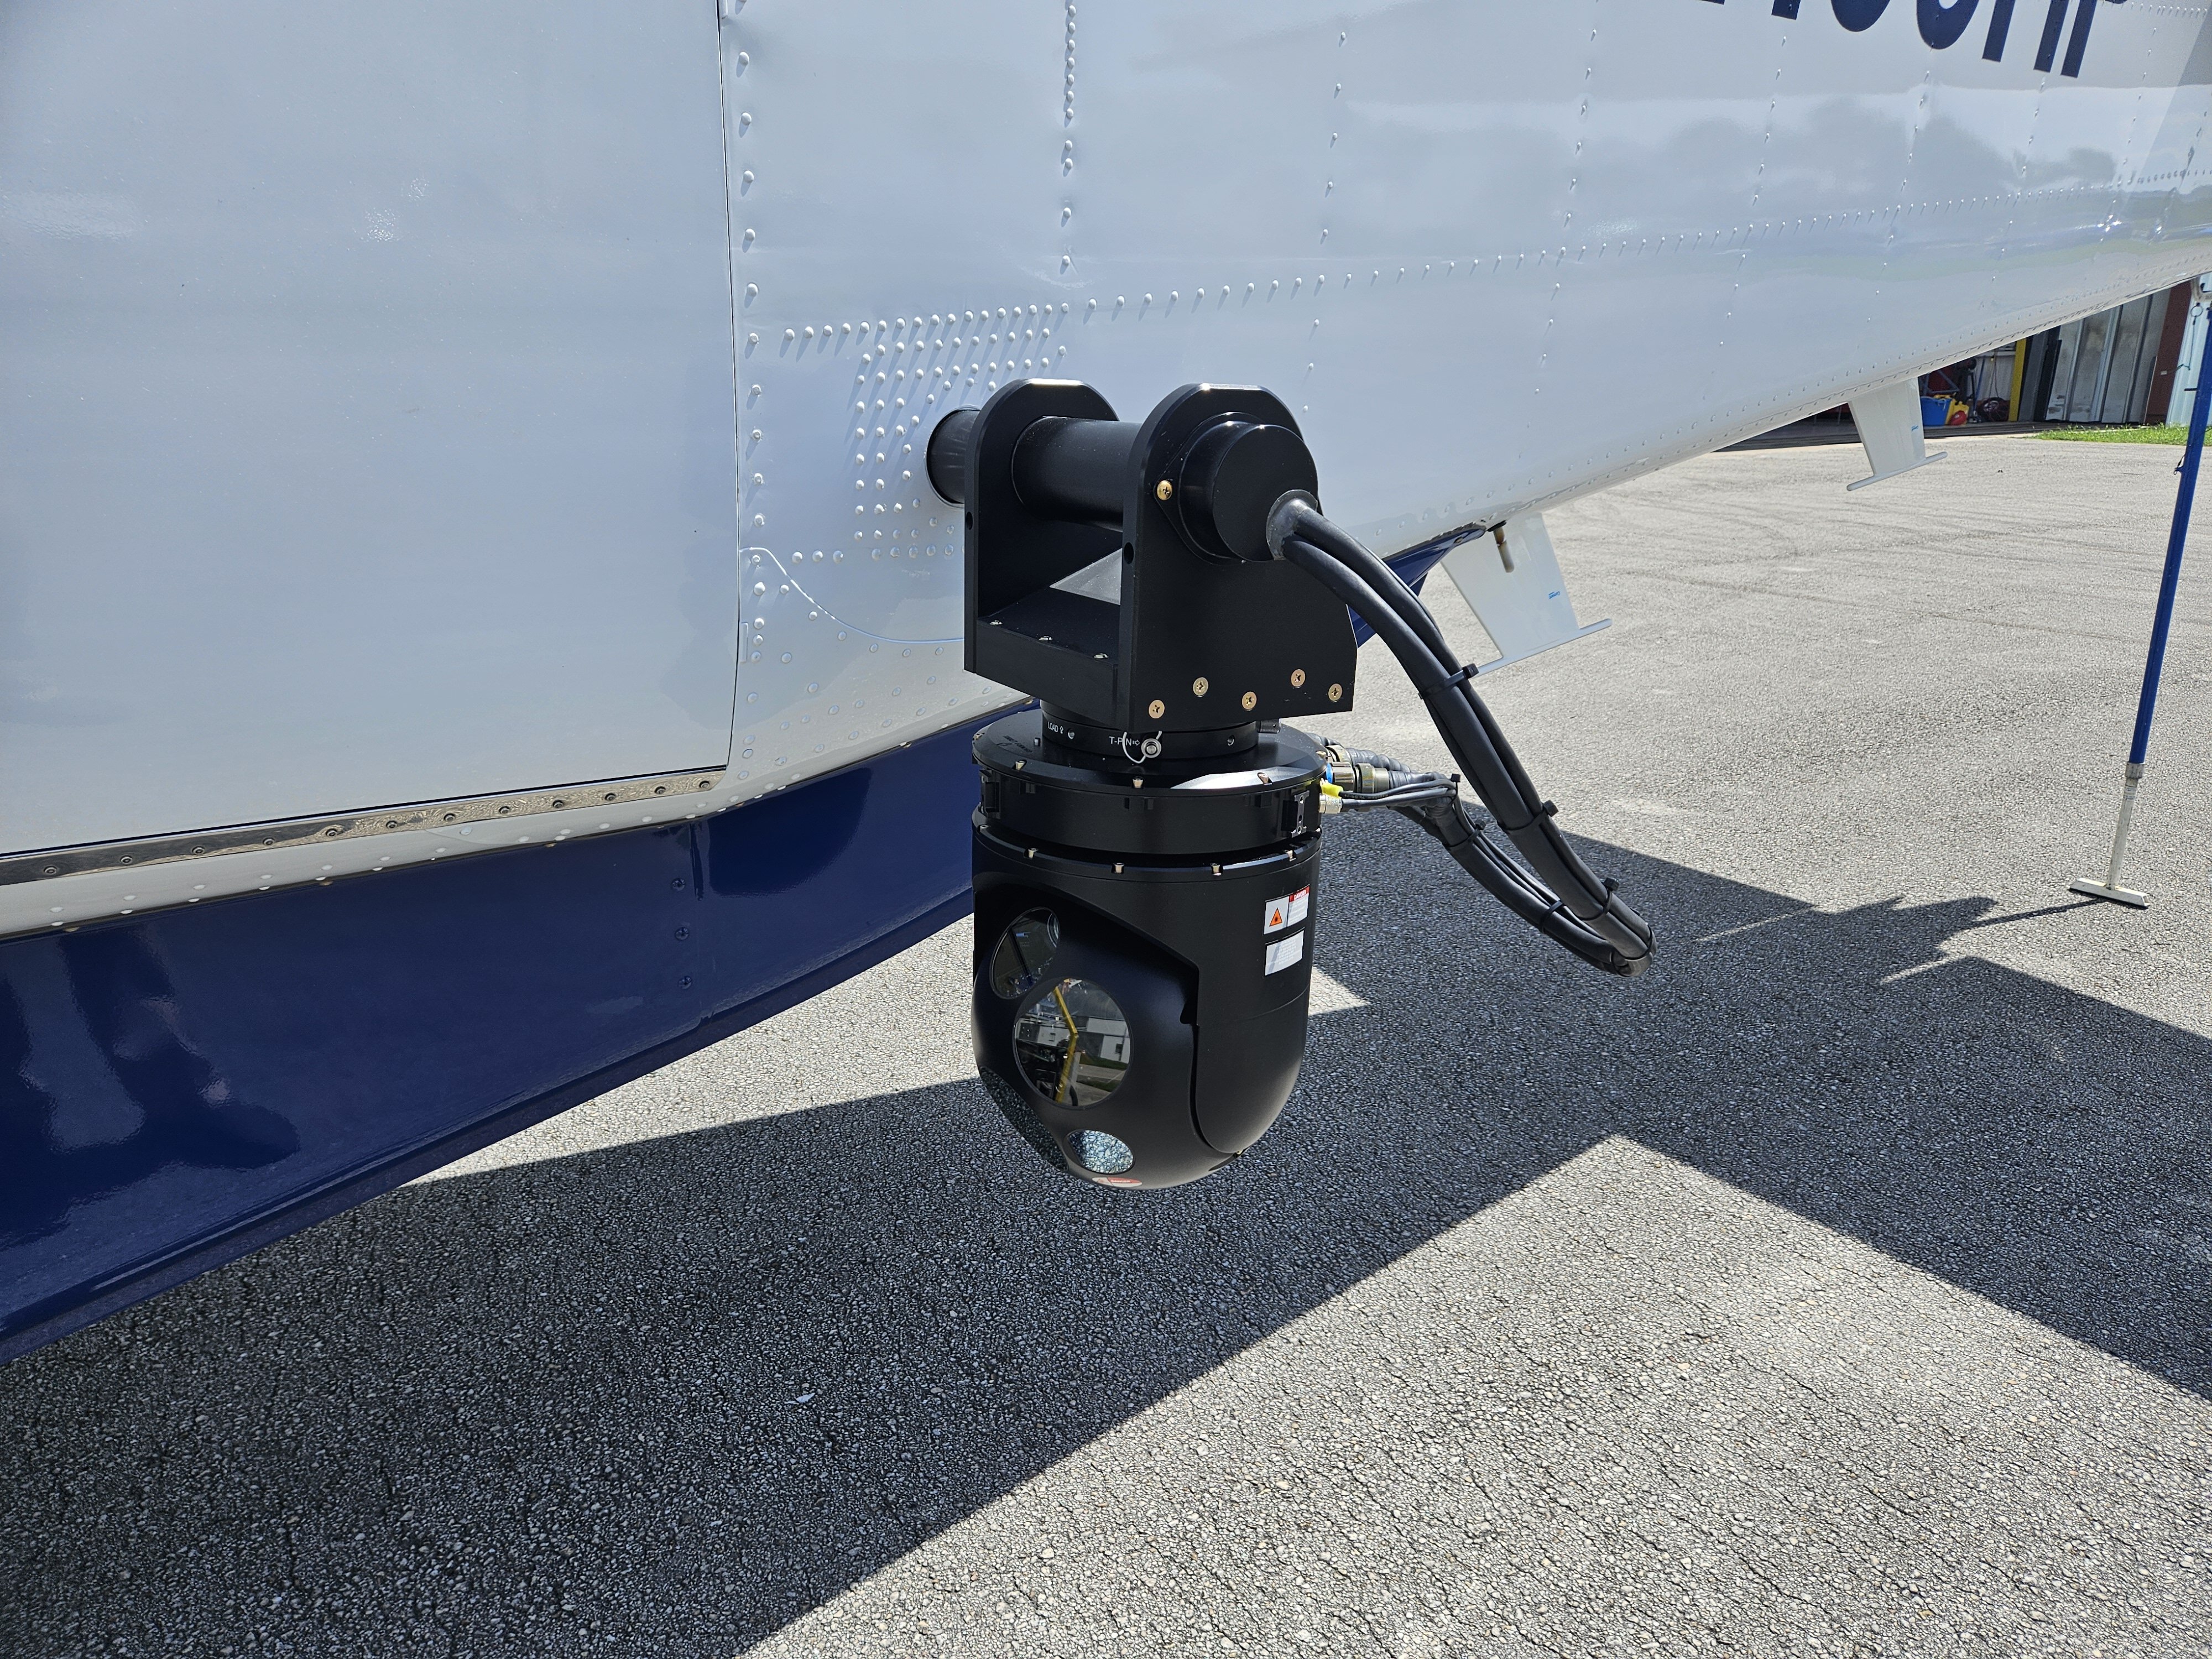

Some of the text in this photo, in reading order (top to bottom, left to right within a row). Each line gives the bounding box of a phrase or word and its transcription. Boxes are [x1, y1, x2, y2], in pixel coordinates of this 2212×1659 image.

[1047, 721, 1058, 732] LOAD
[1109, 736, 1132, 746] T-PN
[1293, 889, 1307, 900] DANGER
